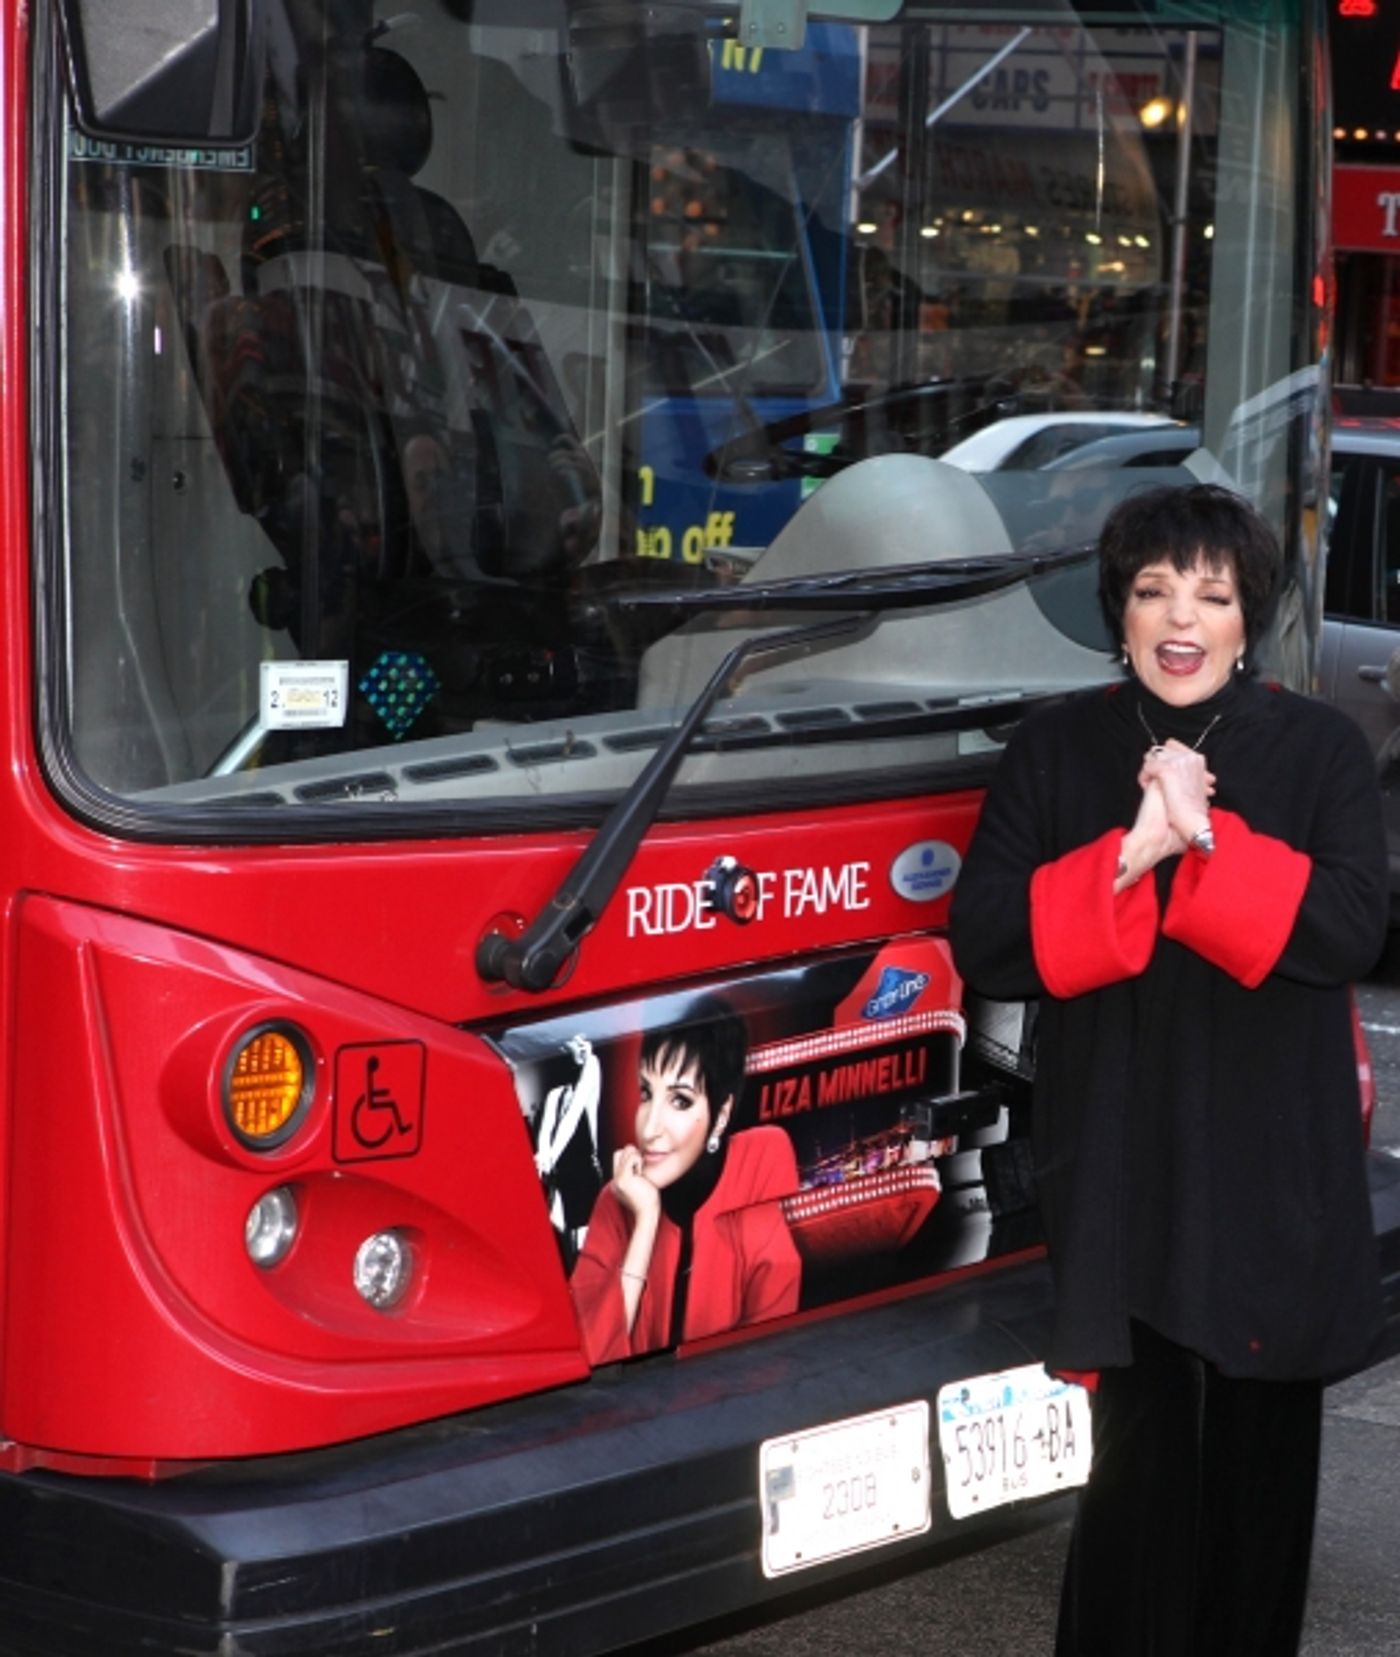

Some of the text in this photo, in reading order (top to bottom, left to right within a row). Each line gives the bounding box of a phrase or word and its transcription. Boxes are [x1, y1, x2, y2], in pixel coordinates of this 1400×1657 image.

[681, 511, 736, 564] off
[626, 880, 716, 938] RIDE
[784, 862, 871, 919] FAME
[759, 1047, 928, 1119] LIZA MINNELLI
